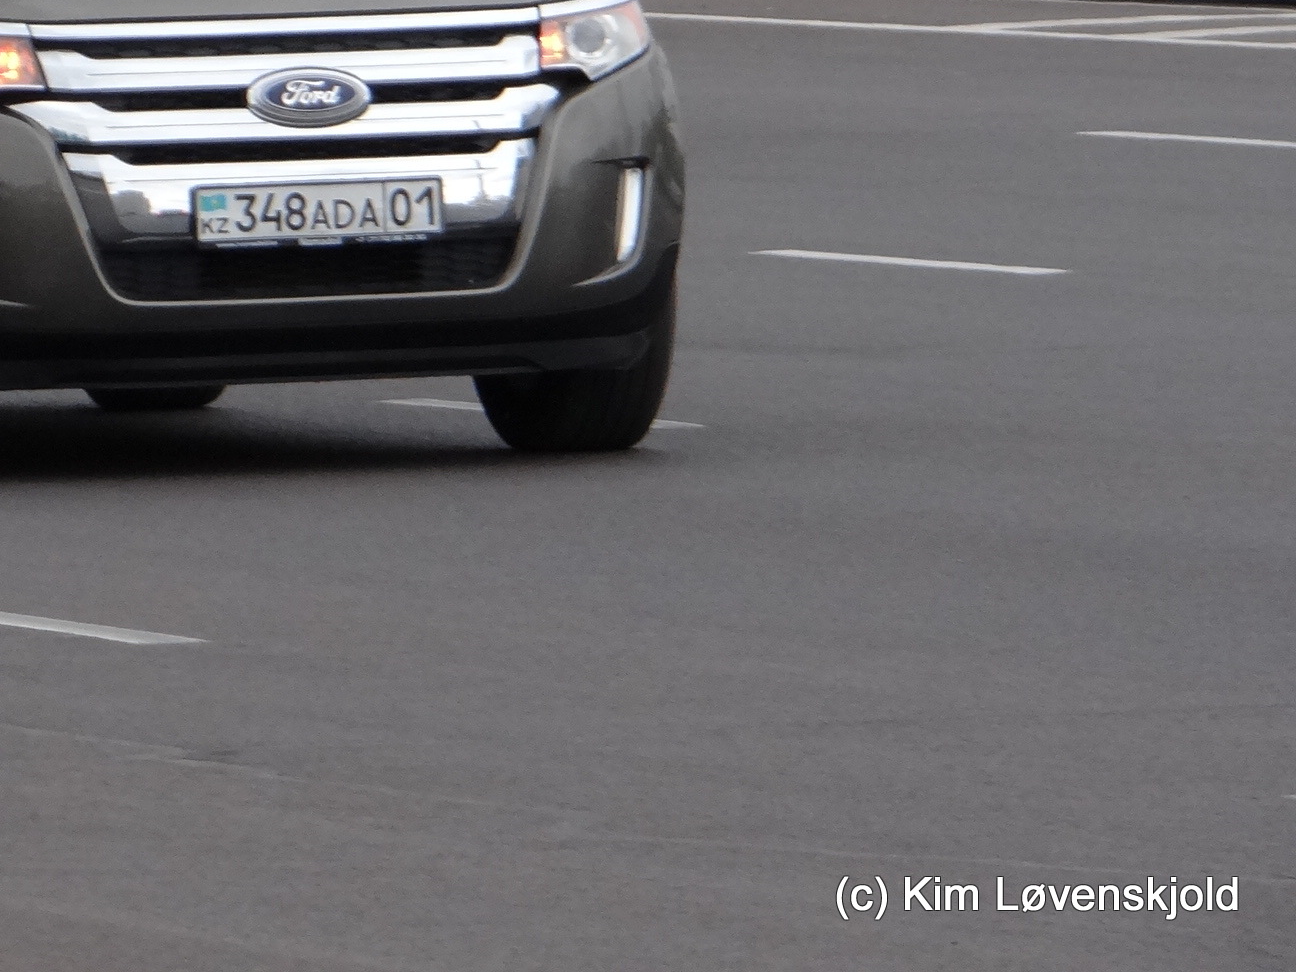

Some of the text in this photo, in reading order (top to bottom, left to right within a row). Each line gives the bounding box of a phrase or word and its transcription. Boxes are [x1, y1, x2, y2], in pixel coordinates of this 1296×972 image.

[280, 79, 342, 106] Ford
[234, 185, 436, 233] 348ADA 01
[200, 216, 231, 235] KZ
